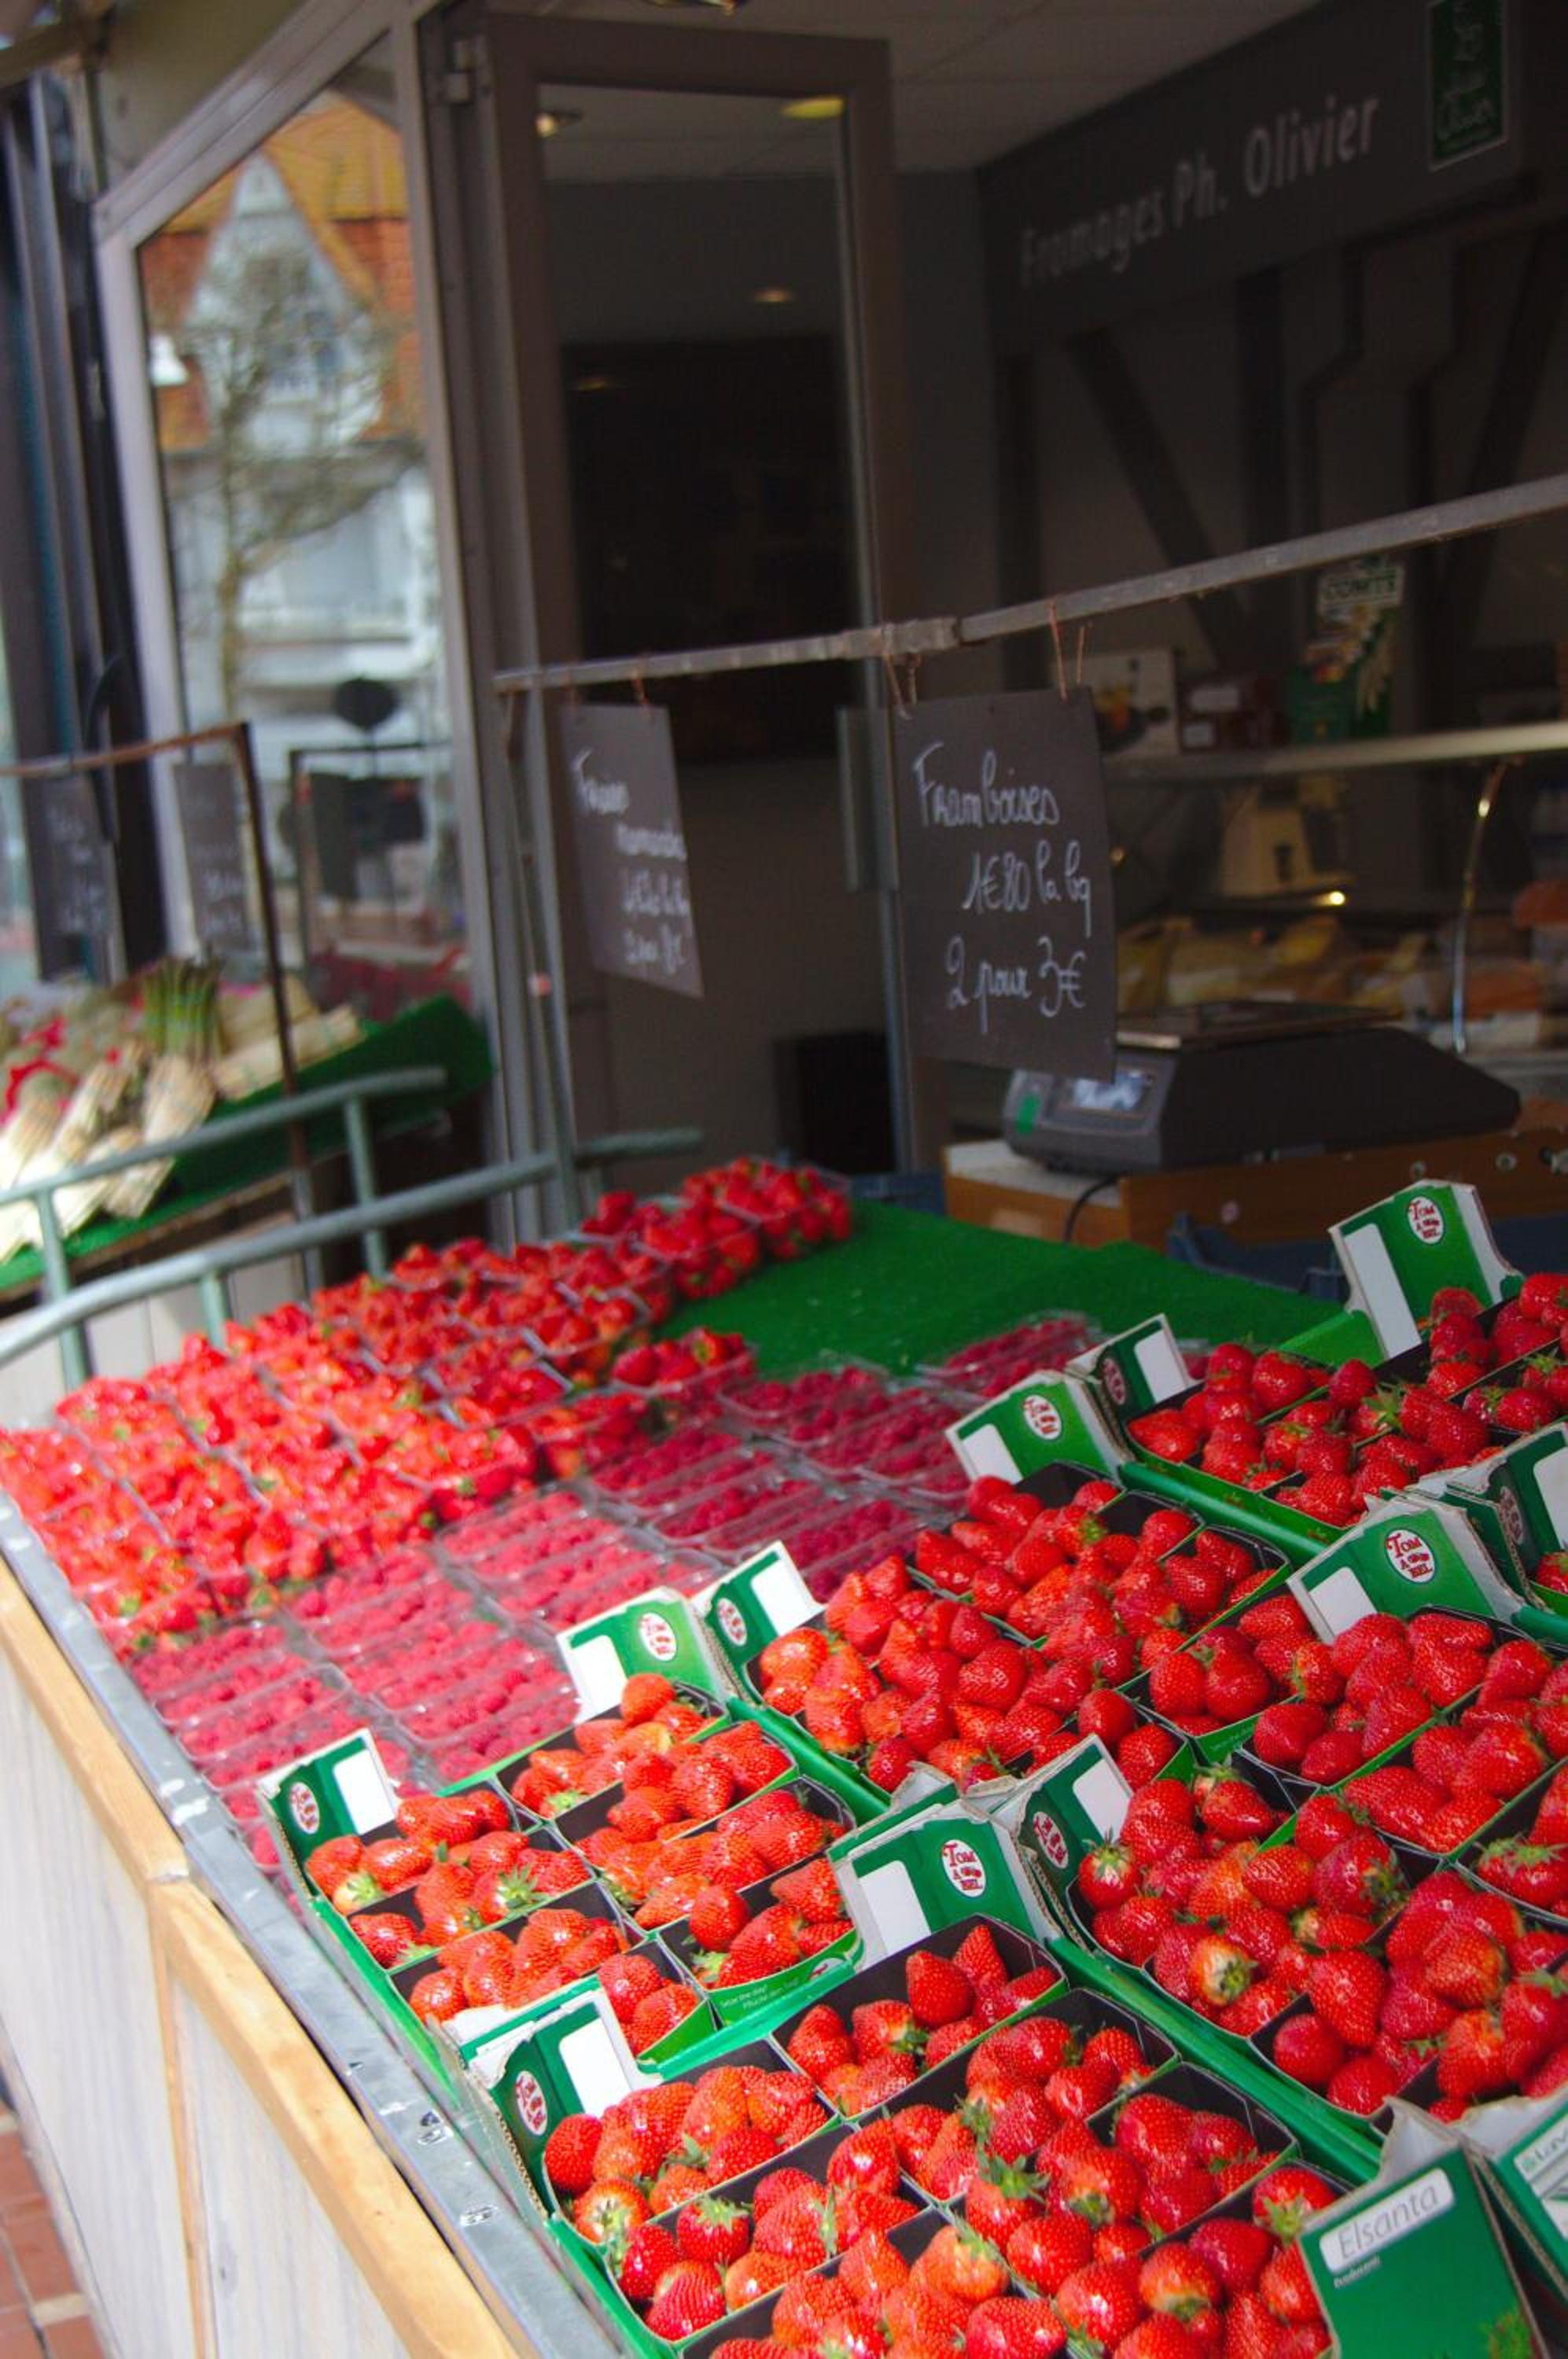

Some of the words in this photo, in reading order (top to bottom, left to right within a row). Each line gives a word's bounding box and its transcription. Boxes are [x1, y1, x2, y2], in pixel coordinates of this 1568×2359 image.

[1021, 188, 1163, 289] Fromages
[1176, 151, 1230, 227] Ph.
[1243, 94, 1379, 198] Olivier
[912, 740, 1059, 827] Framboises
[945, 935, 970, 1010] 2
[972, 960, 1032, 1035] pour
[1037, 936, 1086, 1018] 3€
[1337, 2184, 1438, 2260] Elsanta
